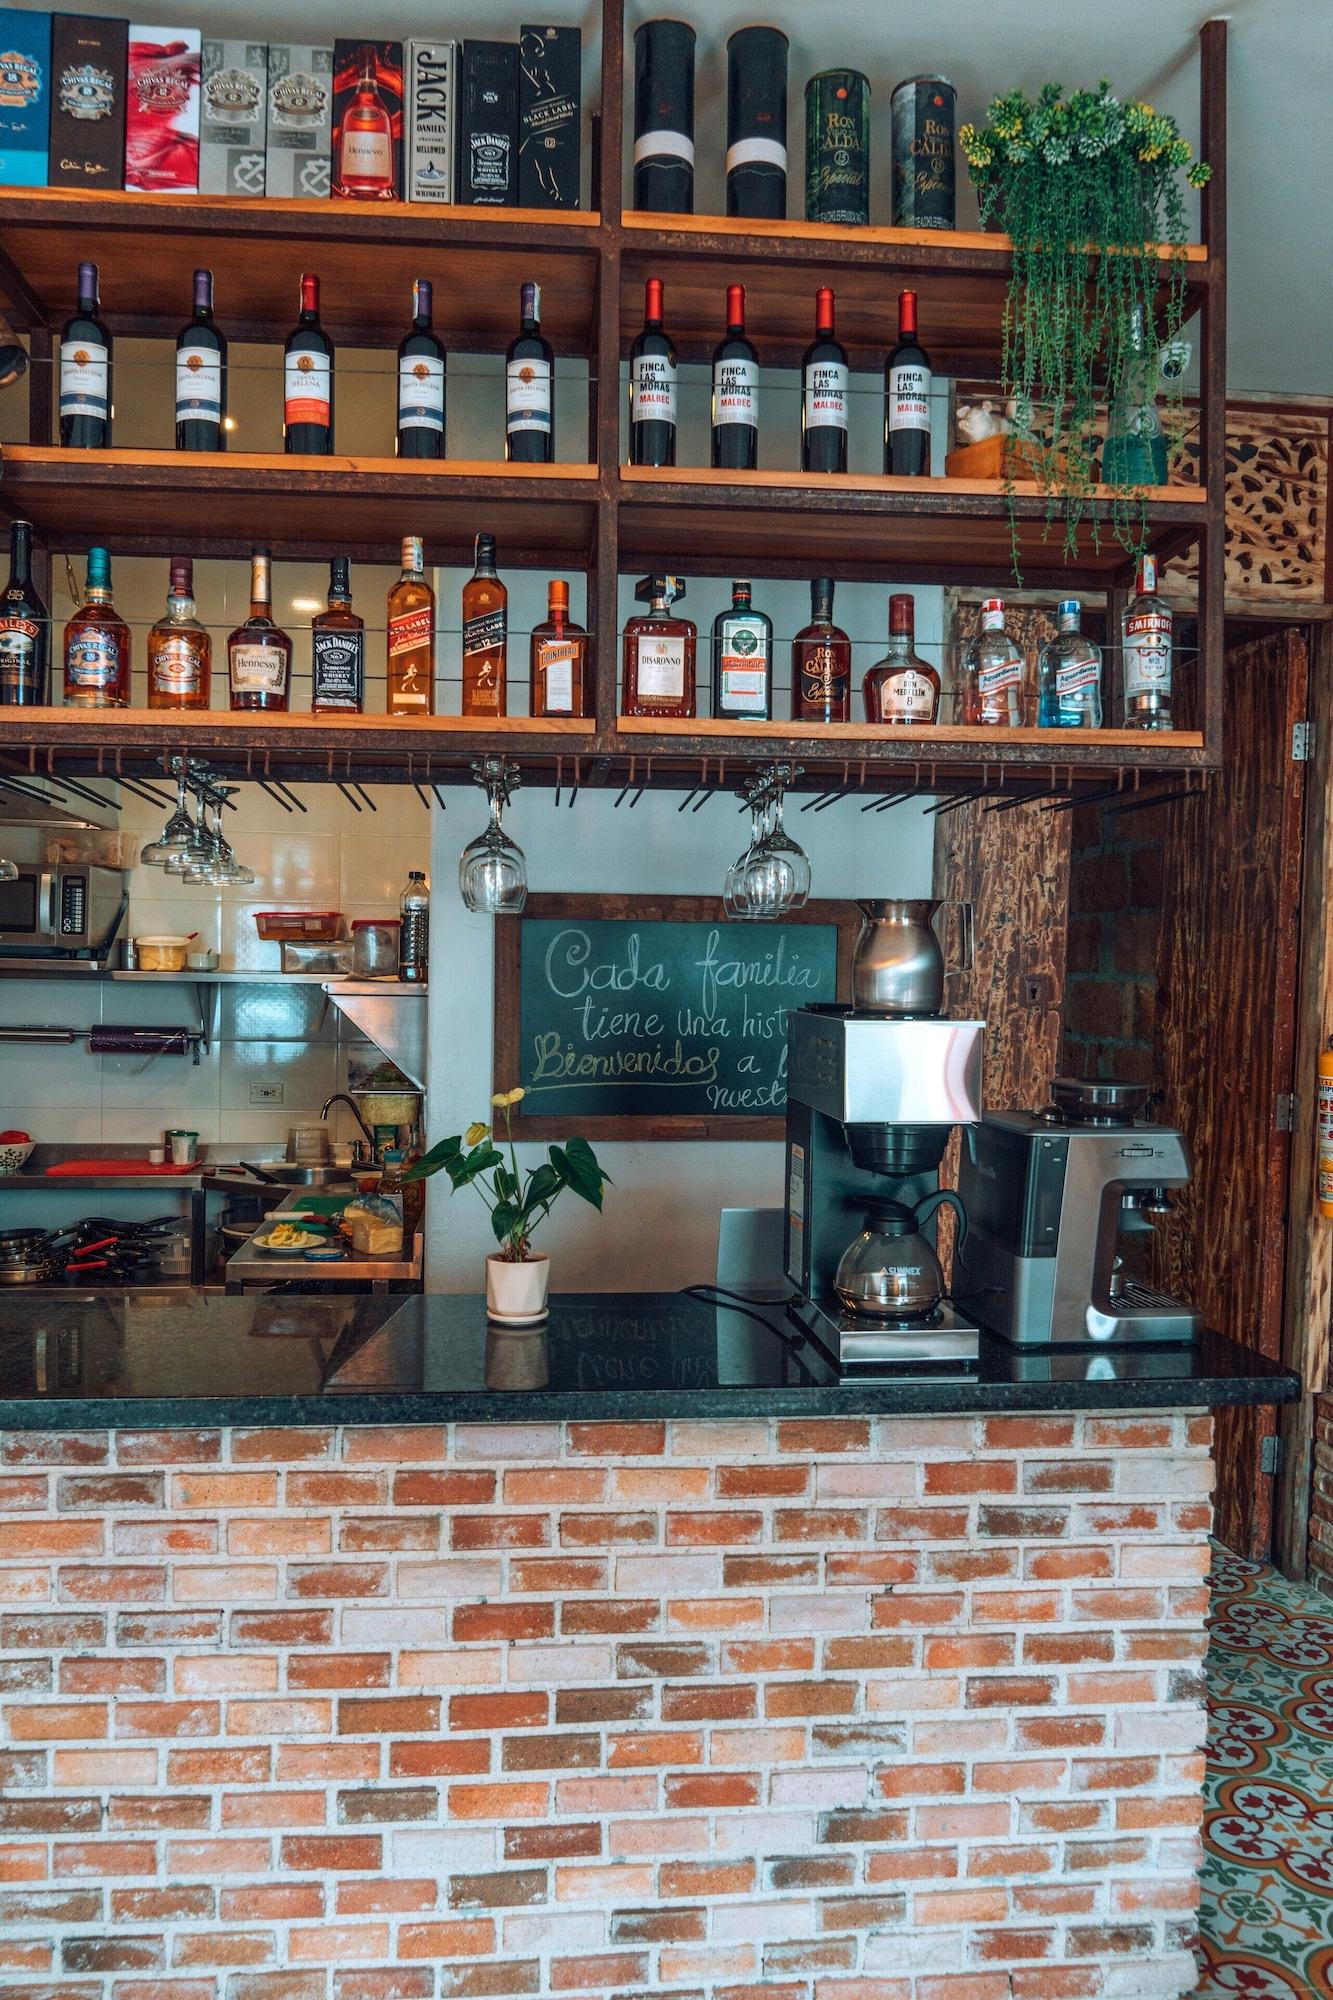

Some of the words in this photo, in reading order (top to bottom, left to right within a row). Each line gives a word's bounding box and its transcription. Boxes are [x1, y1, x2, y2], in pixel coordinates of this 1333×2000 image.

[61, 76, 88, 86] CHIVAS
[137, 76, 164, 88] CHIVAS
[208, 83, 234, 92] CHIVAS
[416, 51, 447, 122] JACK
[275, 87, 300, 97] CHIVAS
[523, 110, 550, 124] BLACK
[551, 102, 578, 115] LABEL
[348, 145, 384, 155] Hennessy
[416, 145, 446, 155] MELLOWED
[415, 190, 445, 199] WHISKEY
[640, 363, 666, 373] FINCA
[721, 366, 747, 377] FINCA
[640, 372, 656, 382] LAS
[813, 370, 839, 380] FINCA
[897, 373, 923, 383] FINCA
[721, 376, 737, 386] LAS
[813, 379, 829, 389] LAS
[639, 382, 670, 393] MORAS
[720, 386, 751, 397] MORAS
[897, 382, 914, 391] LAS
[639, 394, 670, 405] MALBEC
[813, 390, 843, 400] MORAS
[897, 393, 927, 403] MORAS
[720, 397, 751, 408] MALBEC
[813, 401, 843, 411] MALBEC
[897, 403, 927, 414] MALBEC
[405, 617, 431, 630] LABEL
[315, 641, 332, 653] JACK
[481, 638, 492, 648] 12
[69, 642, 91, 654] CHIVAS
[92, 643, 116, 656] REGAL
[86, 652, 95, 661] 18
[154, 654, 179, 664] CHIVAS
[179, 654, 201, 667] REGAL
[642, 656, 681, 665] DISARONNO
[0, 658, 31, 666] RIGINAL
[237, 658, 277, 670] Hennessy
[322, 663, 351, 671] Tennessee
[982, 665, 1019, 682] Aguardiente
[1060, 665, 1097, 682] Aguardiente
[907, 696, 913, 706] 8
[545, 929, 671, 998] Cada
[694, 929, 822, 1021] familia
[573, 996, 665, 1041] tiene
[742, 994, 788, 1039] hist
[530, 1032, 721, 1084] Bienvenidos
[738, 1056, 761, 1074] a
[706, 1080, 788, 1110] nuest
[888, 1266, 921, 1276] SUNNEX
